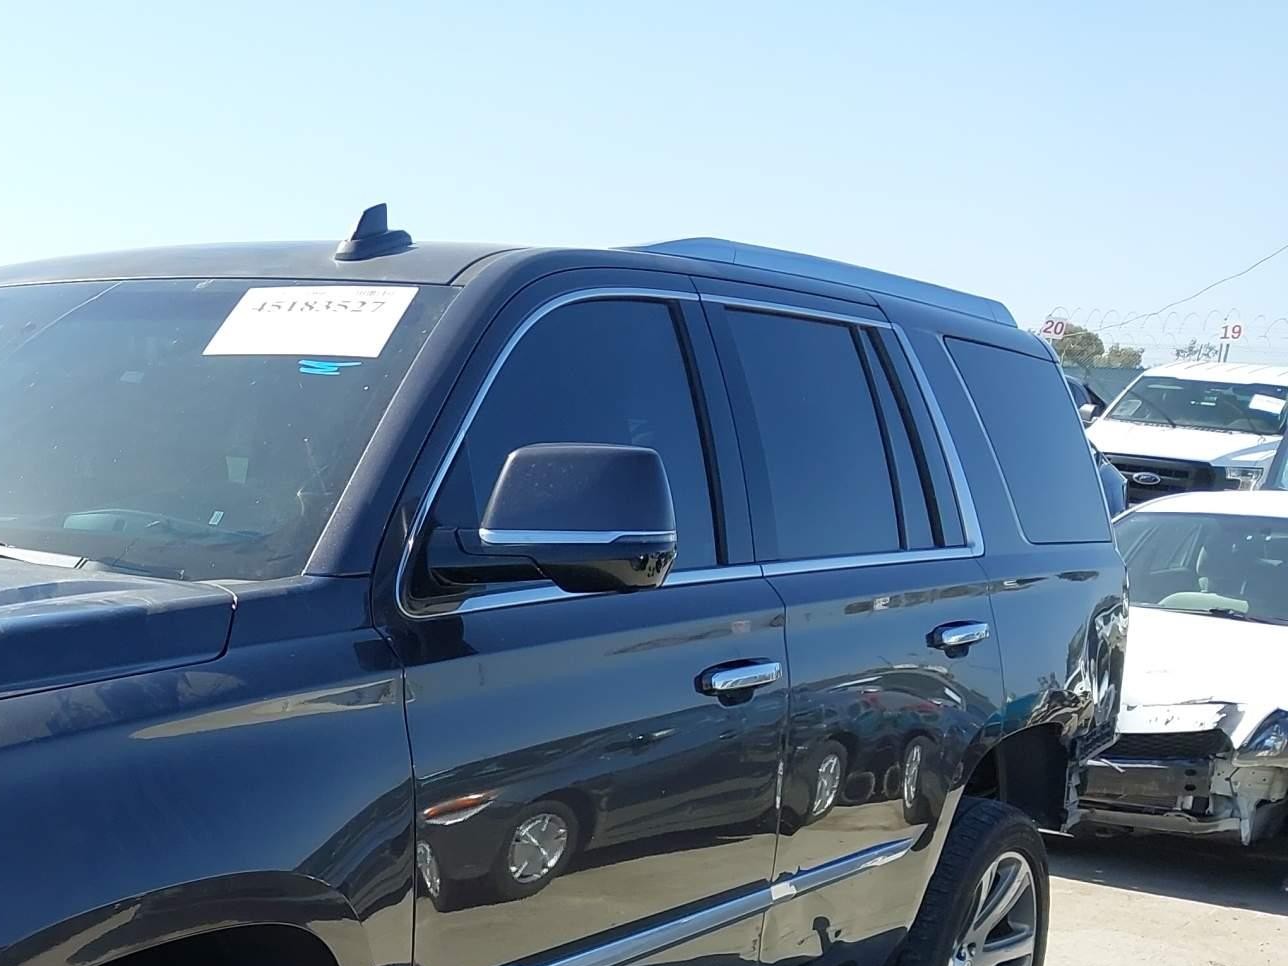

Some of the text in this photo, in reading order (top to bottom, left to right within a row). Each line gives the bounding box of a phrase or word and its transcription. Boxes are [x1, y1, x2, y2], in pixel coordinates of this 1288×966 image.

[252, 300, 386, 313] 45183527
[1043, 320, 1065, 335] 20
[1220, 324, 1242, 339] 19
